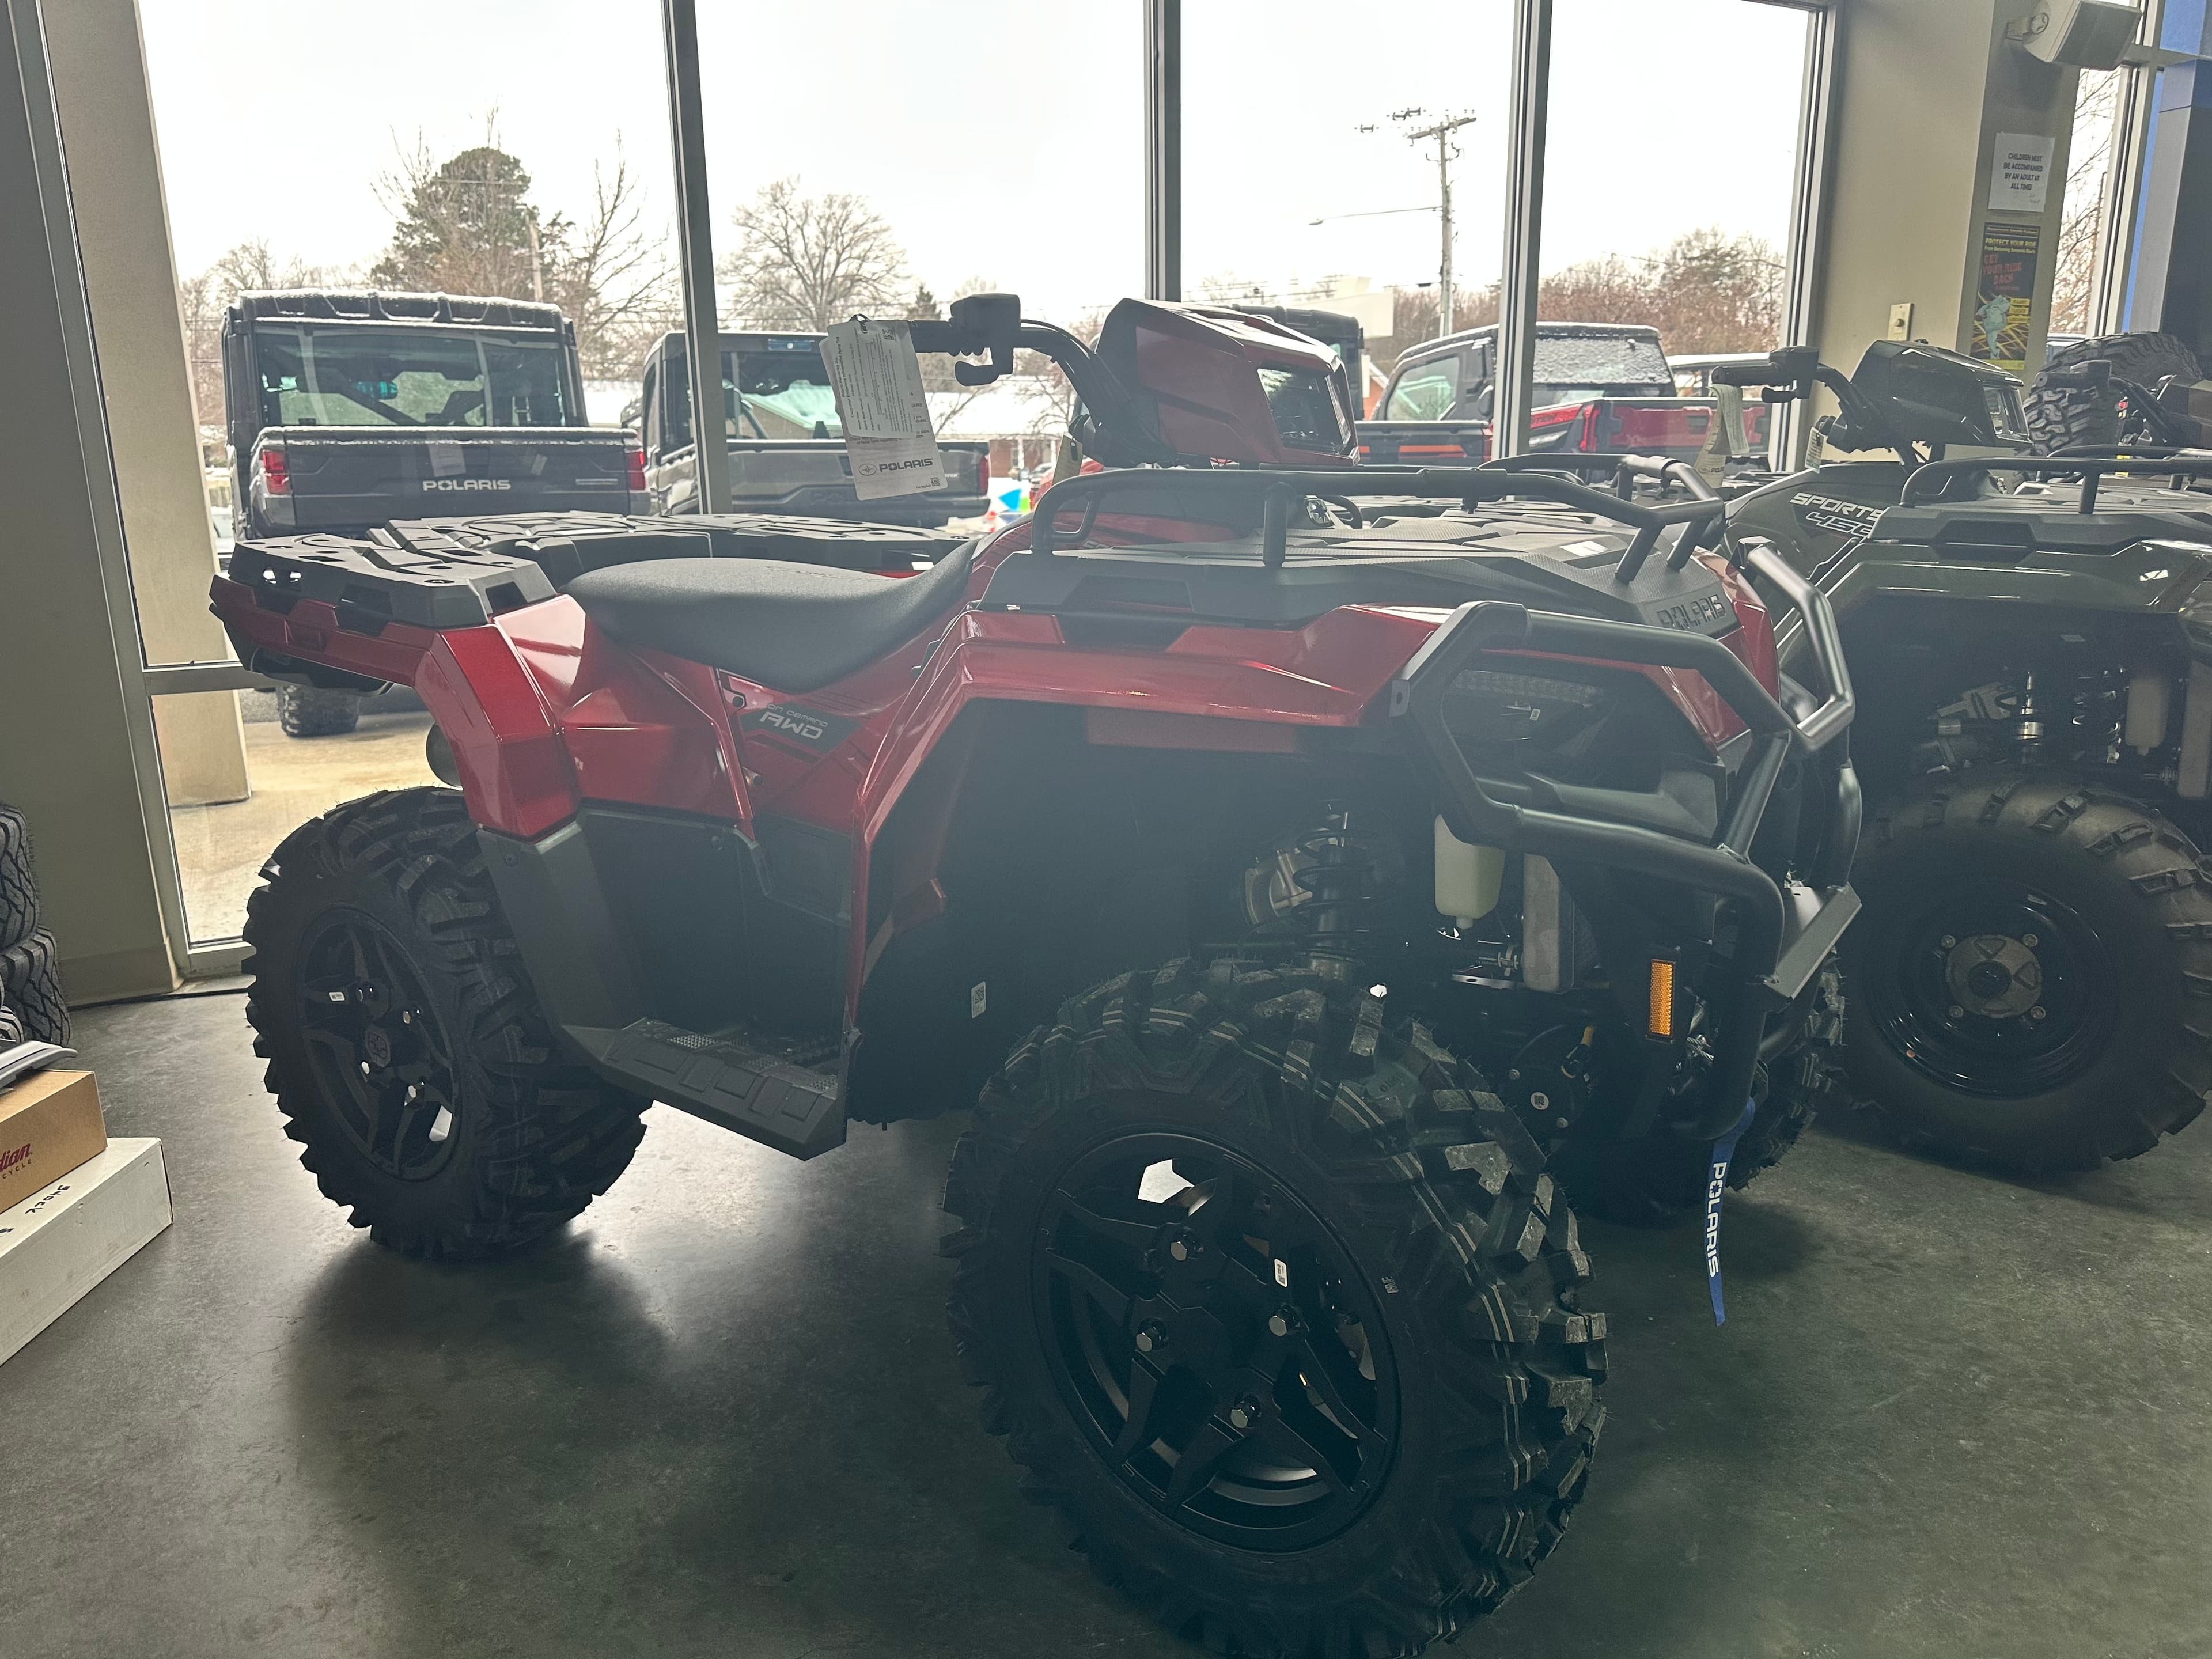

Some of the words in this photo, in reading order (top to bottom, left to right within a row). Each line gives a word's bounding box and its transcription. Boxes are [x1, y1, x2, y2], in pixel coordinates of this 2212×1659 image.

[2008, 153, 2031, 161] CHILDREN
[2011, 162, 2043, 172] ACCOMPANIED
[878, 458, 933, 472] POLARIS
[422, 479, 512, 491] POLARIS
[1657, 594, 1726, 631] POLARIS
[767, 703, 783, 713] ON
[786, 710, 828, 728] DEMAND
[759, 711, 823, 740] AWD
[1706, 1162, 1727, 1277] POLARIS
